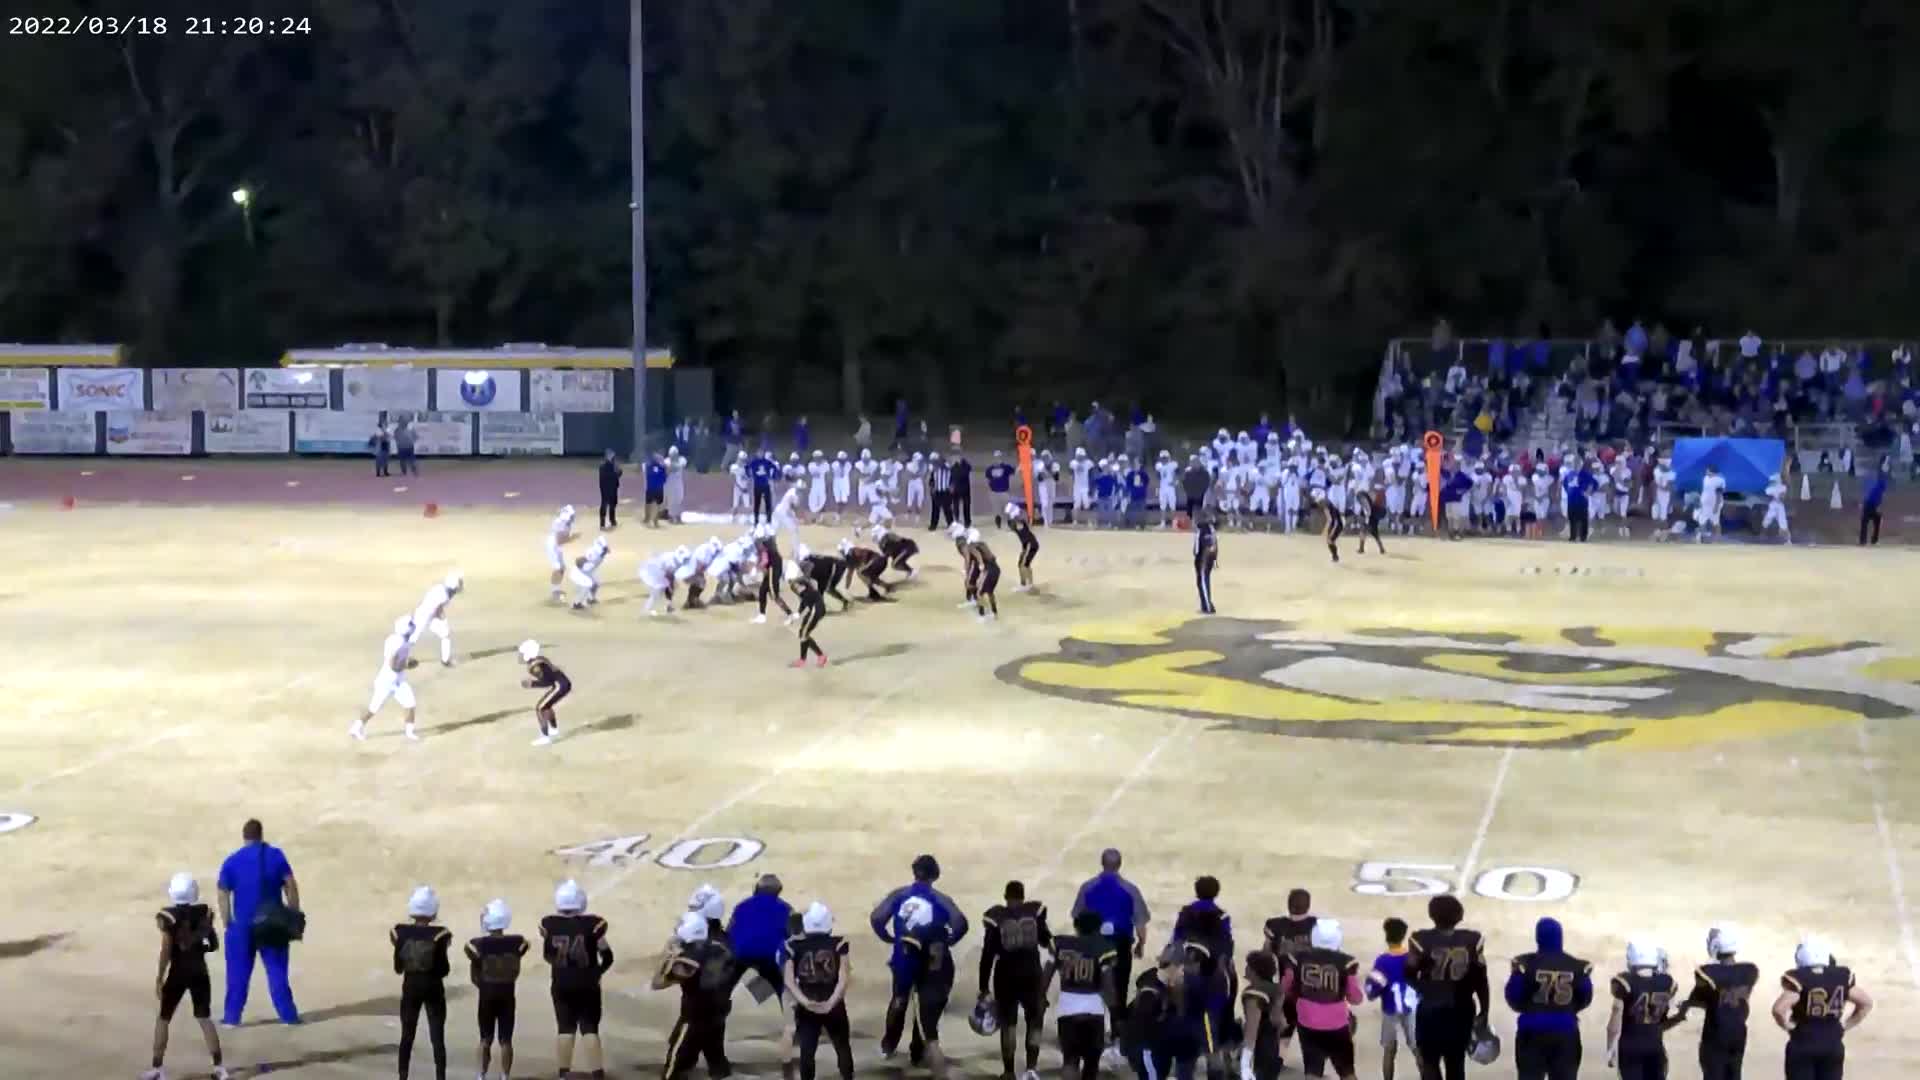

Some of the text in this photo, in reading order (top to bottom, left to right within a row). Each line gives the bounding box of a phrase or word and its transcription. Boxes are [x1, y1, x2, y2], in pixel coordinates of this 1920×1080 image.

[75, 383, 126, 398] SONIC
[552, 833, 766, 870] 40
[1352, 861, 1581, 902] 50
[552, 935, 590, 967] 74
[1535, 969, 1575, 1006] 75
[1806, 985, 1845, 1017] 64
